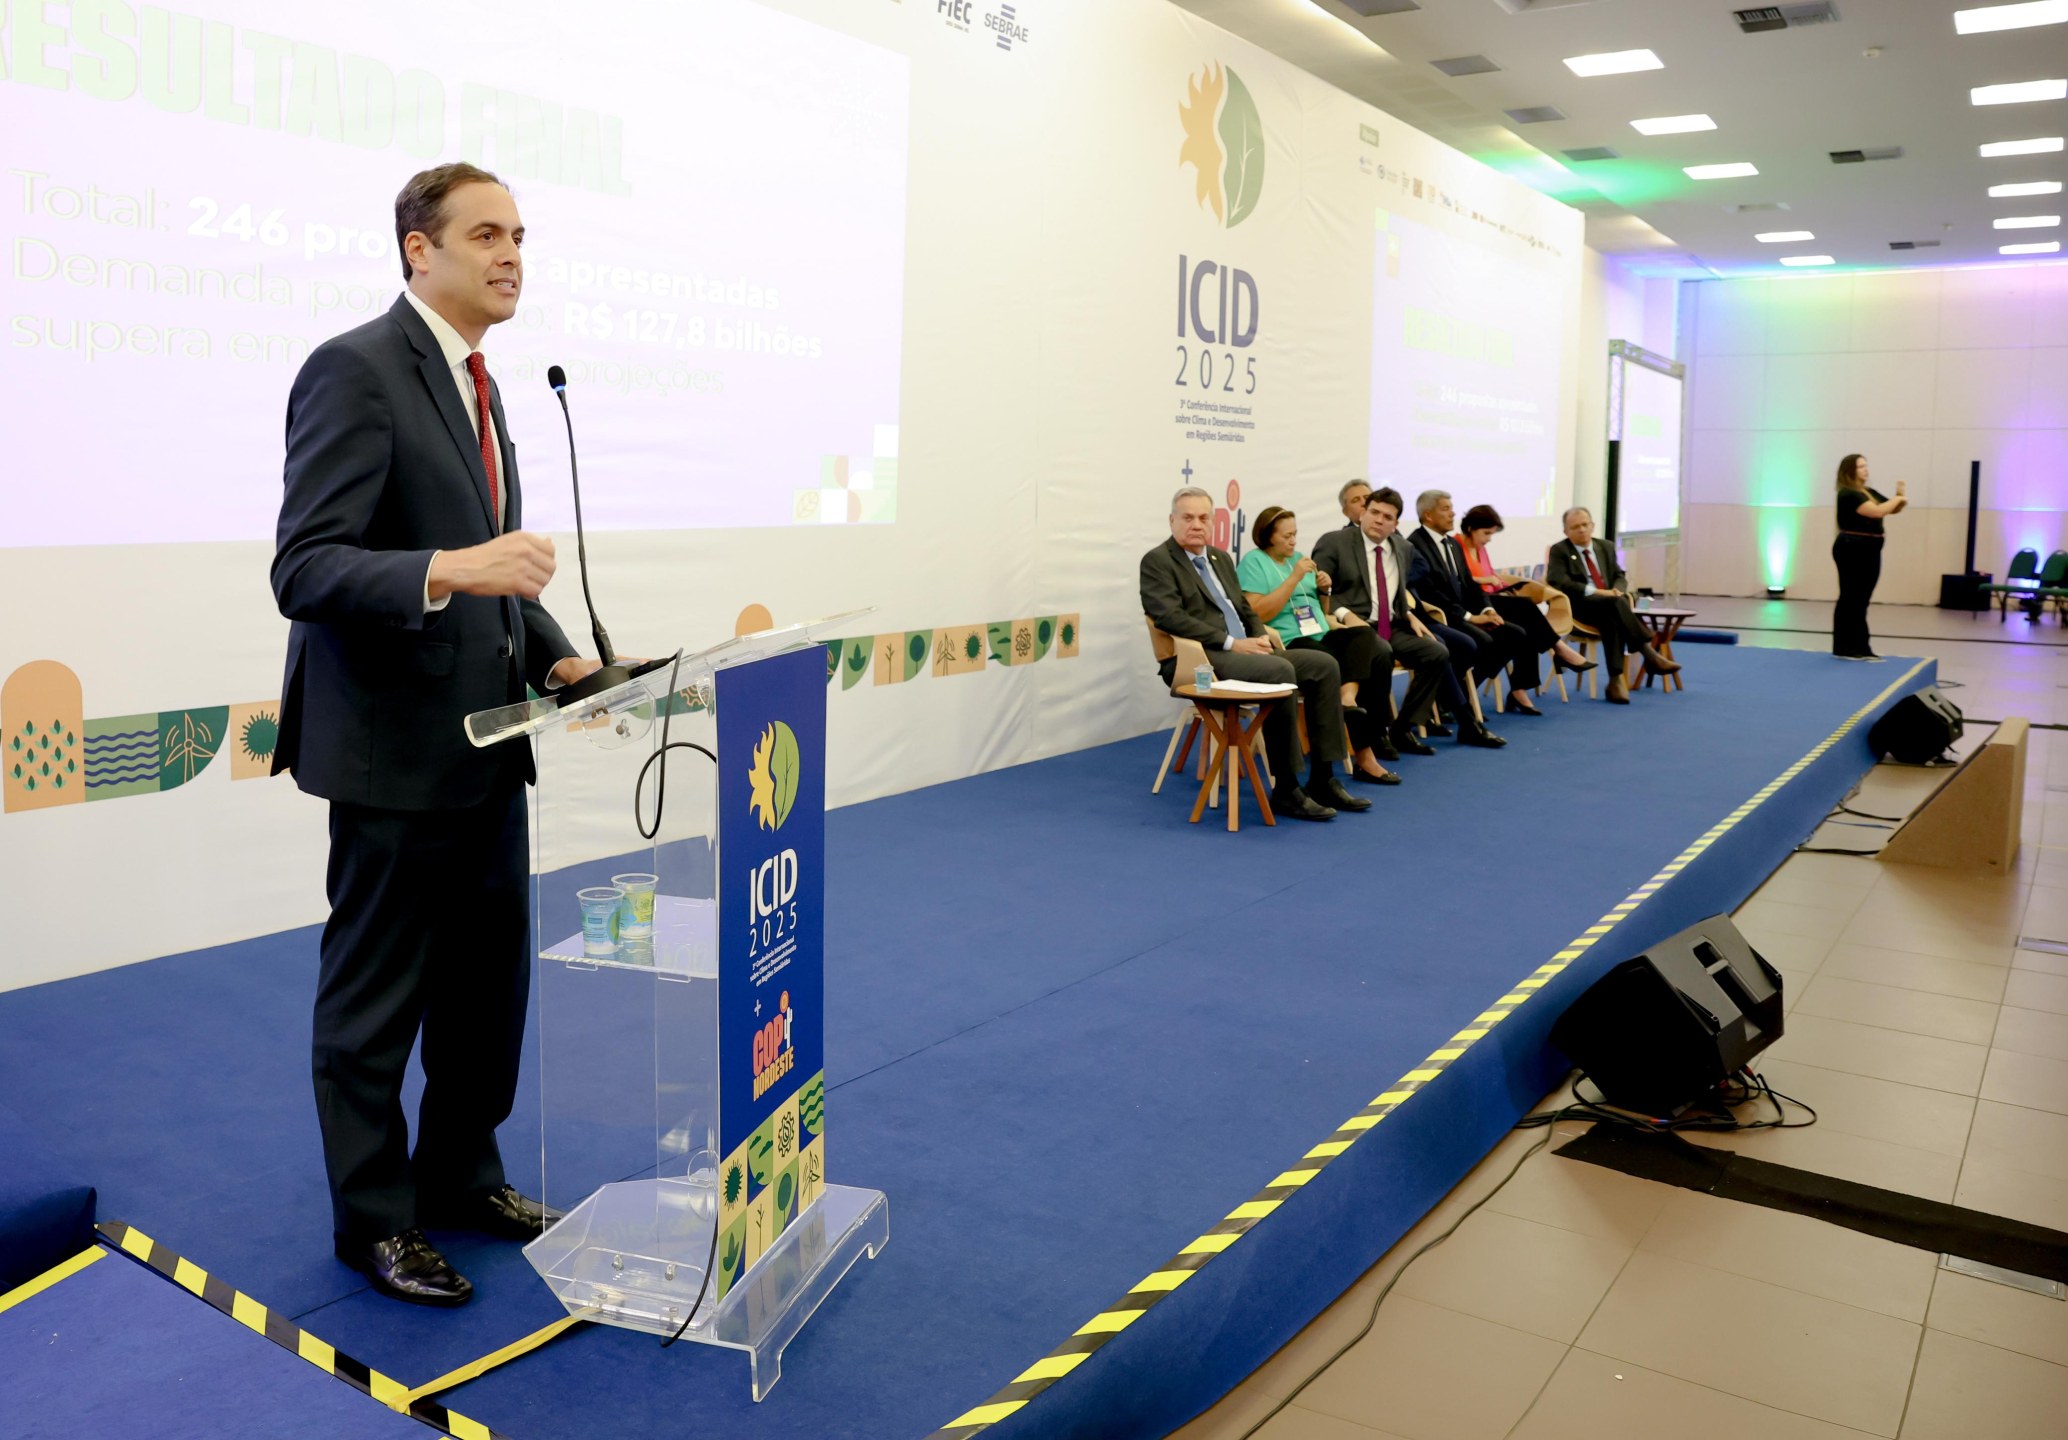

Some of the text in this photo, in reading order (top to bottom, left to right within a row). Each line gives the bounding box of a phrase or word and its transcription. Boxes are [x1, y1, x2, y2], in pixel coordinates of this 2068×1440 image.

[984, 12, 1029, 43] SEBRAE
[0, 0, 632, 199] ESULTADO FINAL
[8, 168, 172, 233] Total:
[185, 195, 291, 248] 246
[12, 236, 293, 306] Demanda
[309, 280, 392, 320] por
[546, 255, 781, 312] apresentadas
[1177, 253, 1260, 349] ICID
[10, 311, 310, 364] supera em
[562, 300, 616, 341] R$
[621, 308, 707, 351] 127,8
[713, 316, 825, 361] bilhões
[1175, 344, 1257, 395] 2025
[749, 848, 798, 926] ICID
[749, 901, 797, 958] 2025
[753, 1045, 794, 1102] NORDESTE
